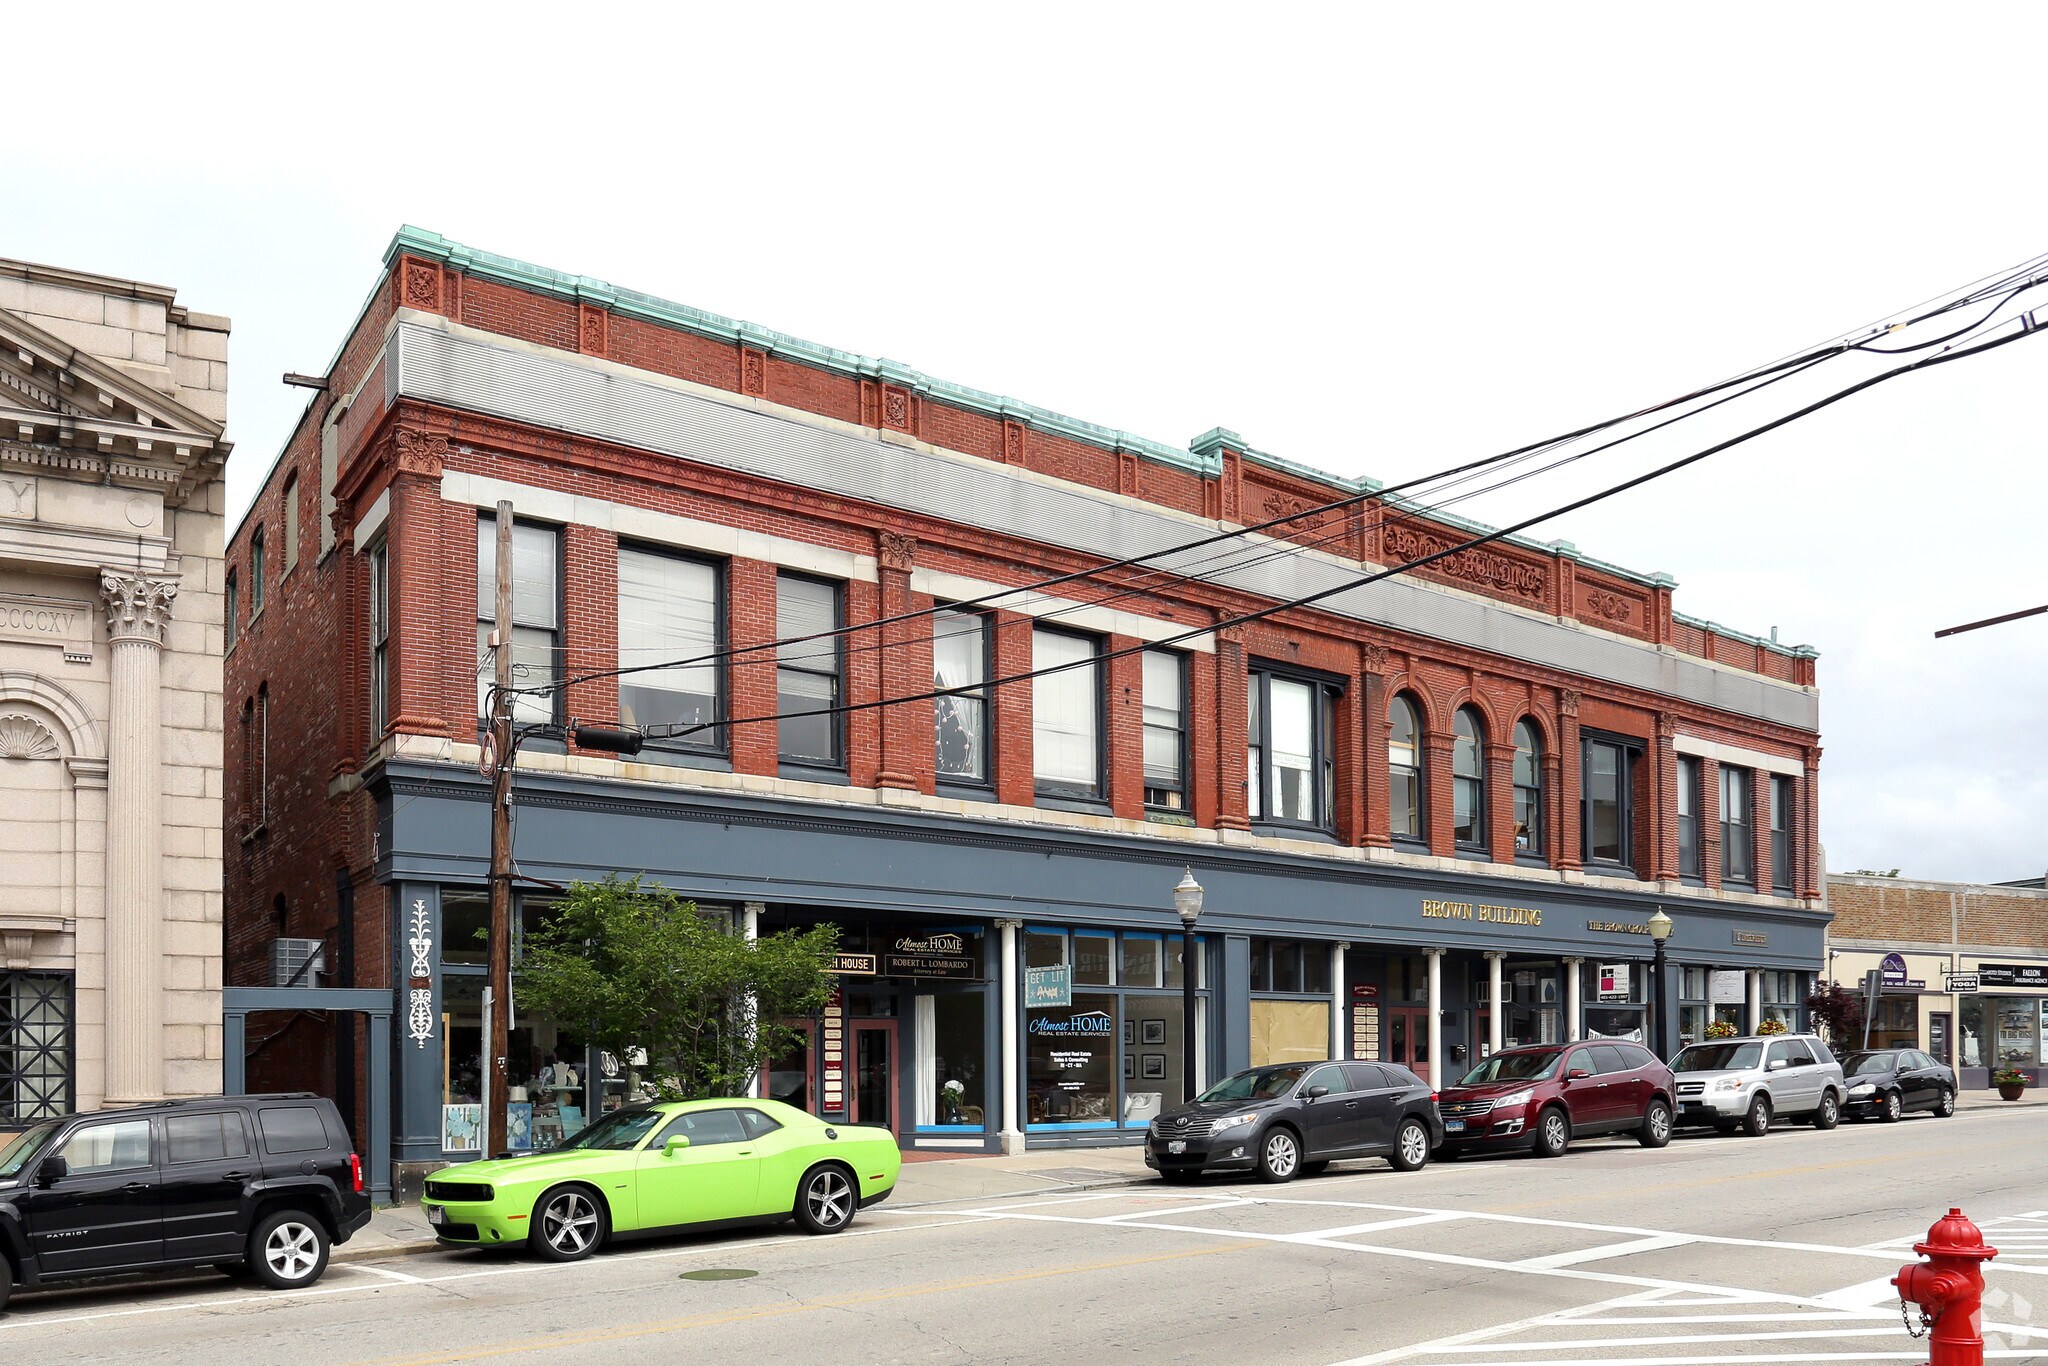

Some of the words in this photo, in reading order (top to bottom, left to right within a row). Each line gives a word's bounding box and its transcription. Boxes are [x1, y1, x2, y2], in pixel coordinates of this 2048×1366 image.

[1422, 899, 1473, 920] BROWN
[1478, 904, 1542, 926] BUILDING
[1588, 920, 1604, 930] THE
[1604, 922, 1627, 932] BROWN
[895, 937, 929, 949] Almost
[929, 938, 963, 951] HOME
[841, 957, 869, 970] HOUSE
[892, 958, 920, 967] ROBERT
[928, 960, 968, 969] LOMBARDO
[1030, 971, 1045, 984] GET
[1051, 970, 1065, 982] LIT
[1029, 1017, 1070, 1033] Almost
[1070, 1017, 1112, 1032] HOME
[1999, 1030, 2007, 1039] TO
[2008, 1030, 2018, 1039] BIG
[2018, 1030, 2033, 1039] RIGS
[46, 1230, 89, 1239] PATRIOT
